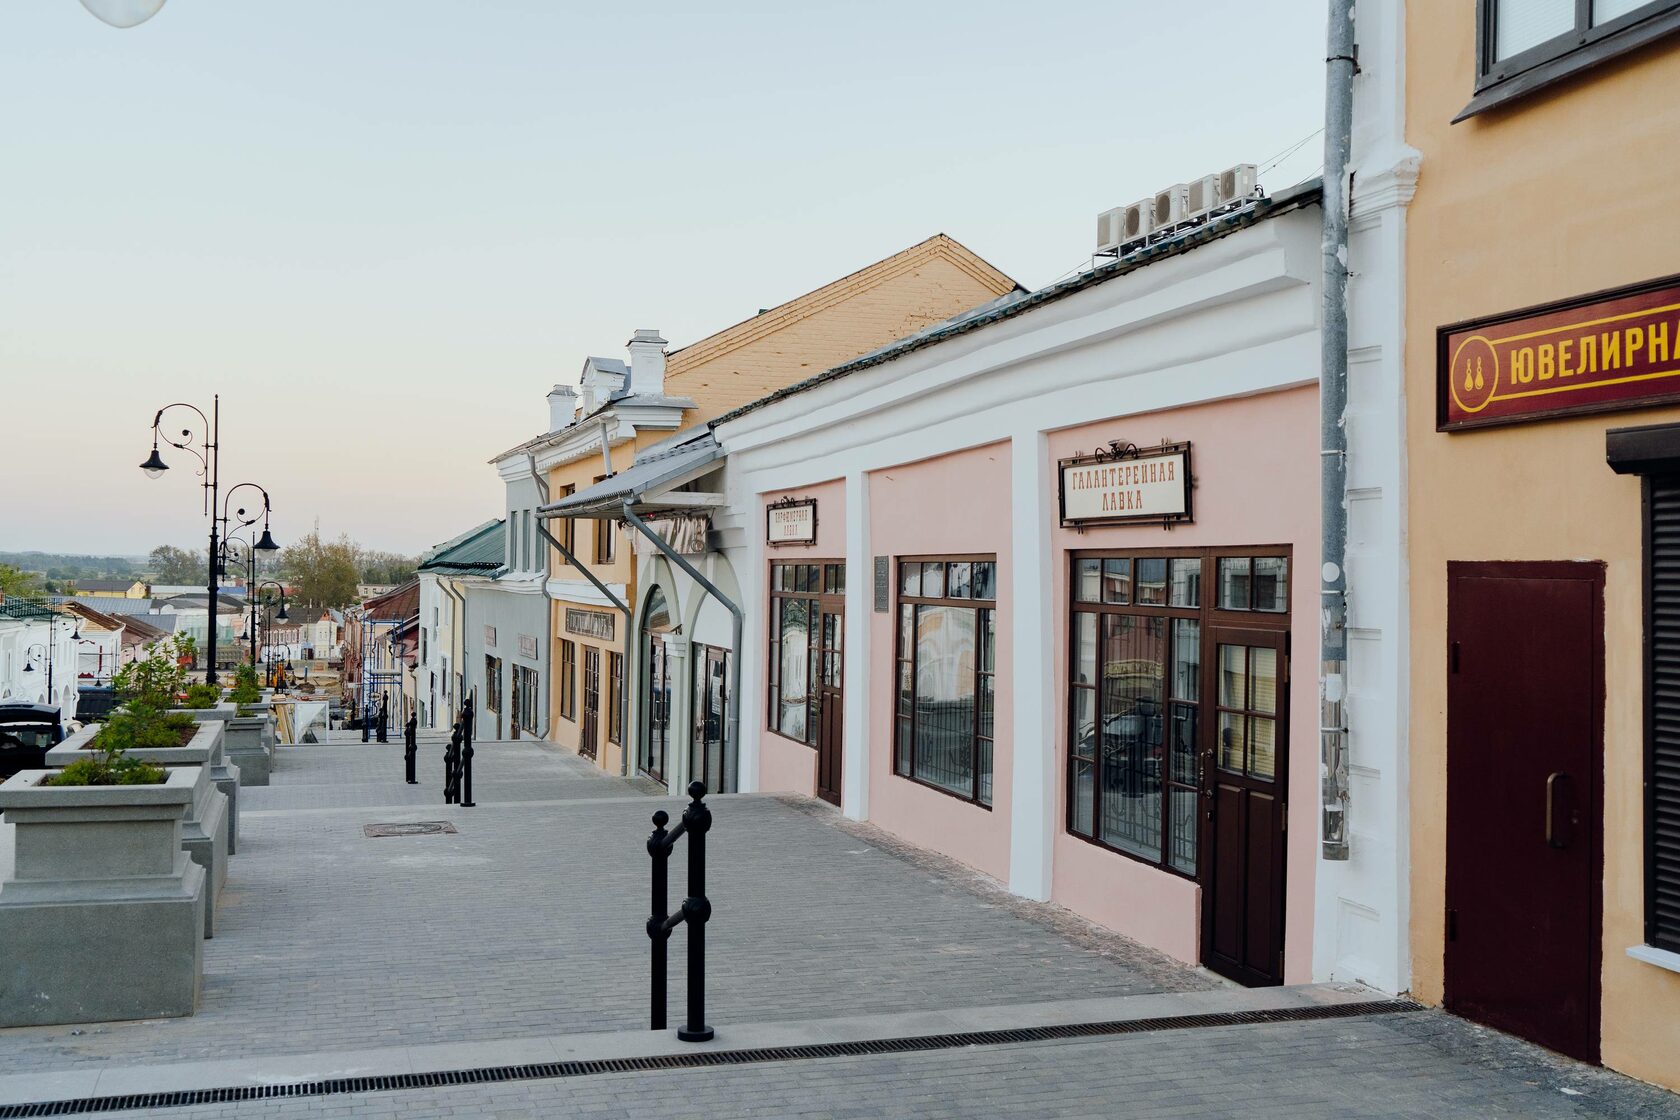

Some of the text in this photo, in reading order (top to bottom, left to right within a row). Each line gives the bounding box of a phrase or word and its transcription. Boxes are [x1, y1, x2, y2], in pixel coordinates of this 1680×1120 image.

[1511, 319, 1680, 385] ЮВЕЛИРН
[1072, 461, 1175, 490] ГАЛАНТЕРЕЙНАЯ
[1102, 490, 1143, 511] ЛАВКА
